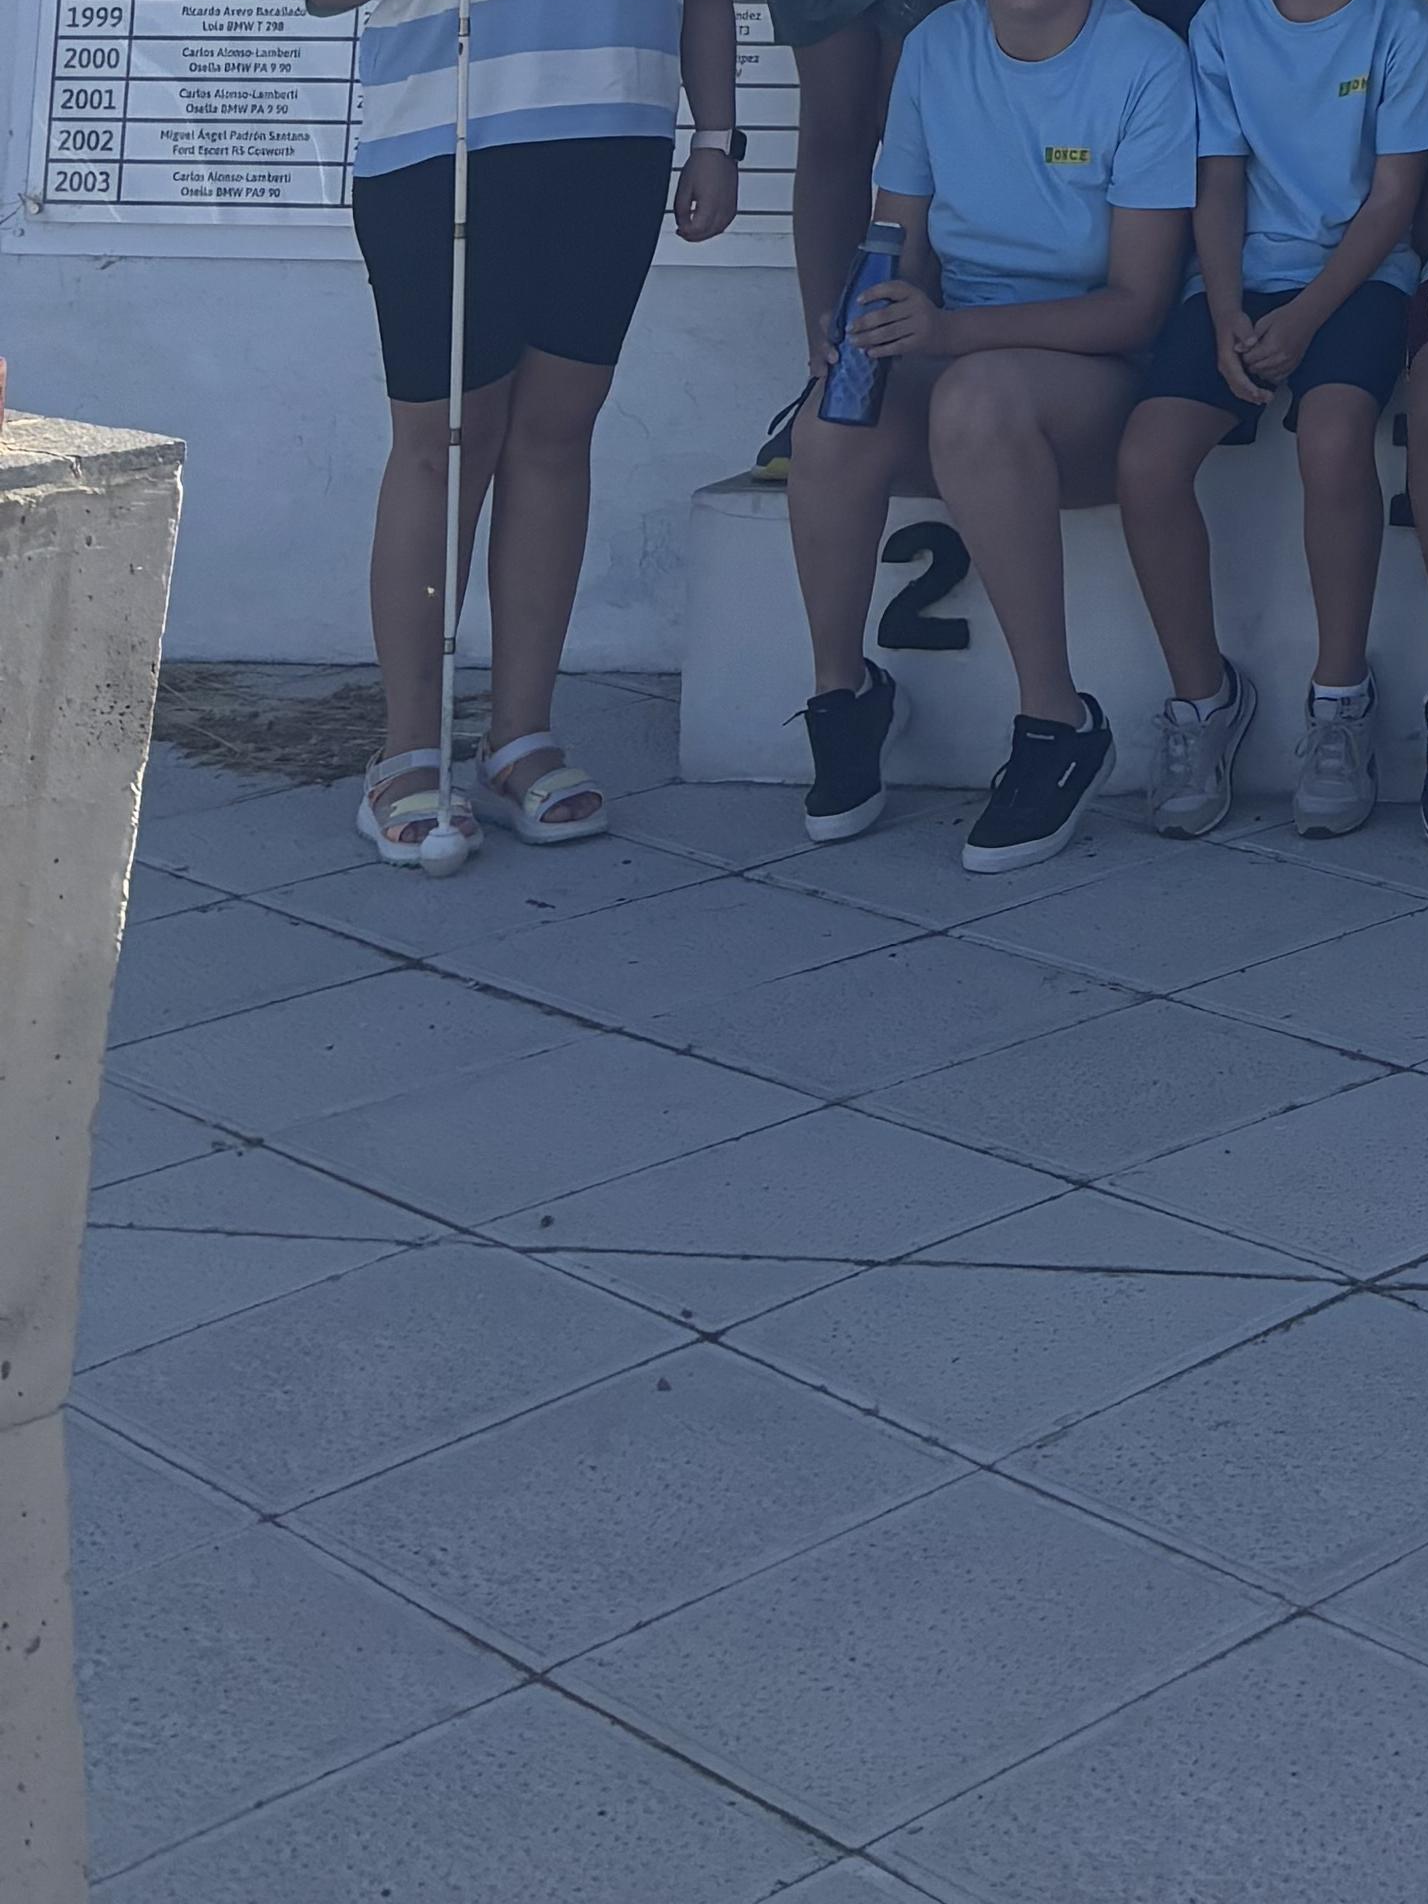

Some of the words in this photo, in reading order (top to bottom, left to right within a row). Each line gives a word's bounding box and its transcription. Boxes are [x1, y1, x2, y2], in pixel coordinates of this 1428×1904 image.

[67, 7, 123, 28] 1999
[64, 48, 120, 69] 2000
[61, 89, 116, 109] 2001
[58, 130, 114, 151] 2002
[1054, 148, 1089, 162] ONCE
[55, 171, 110, 192] 2003
[878, 521, 970, 650] 2
